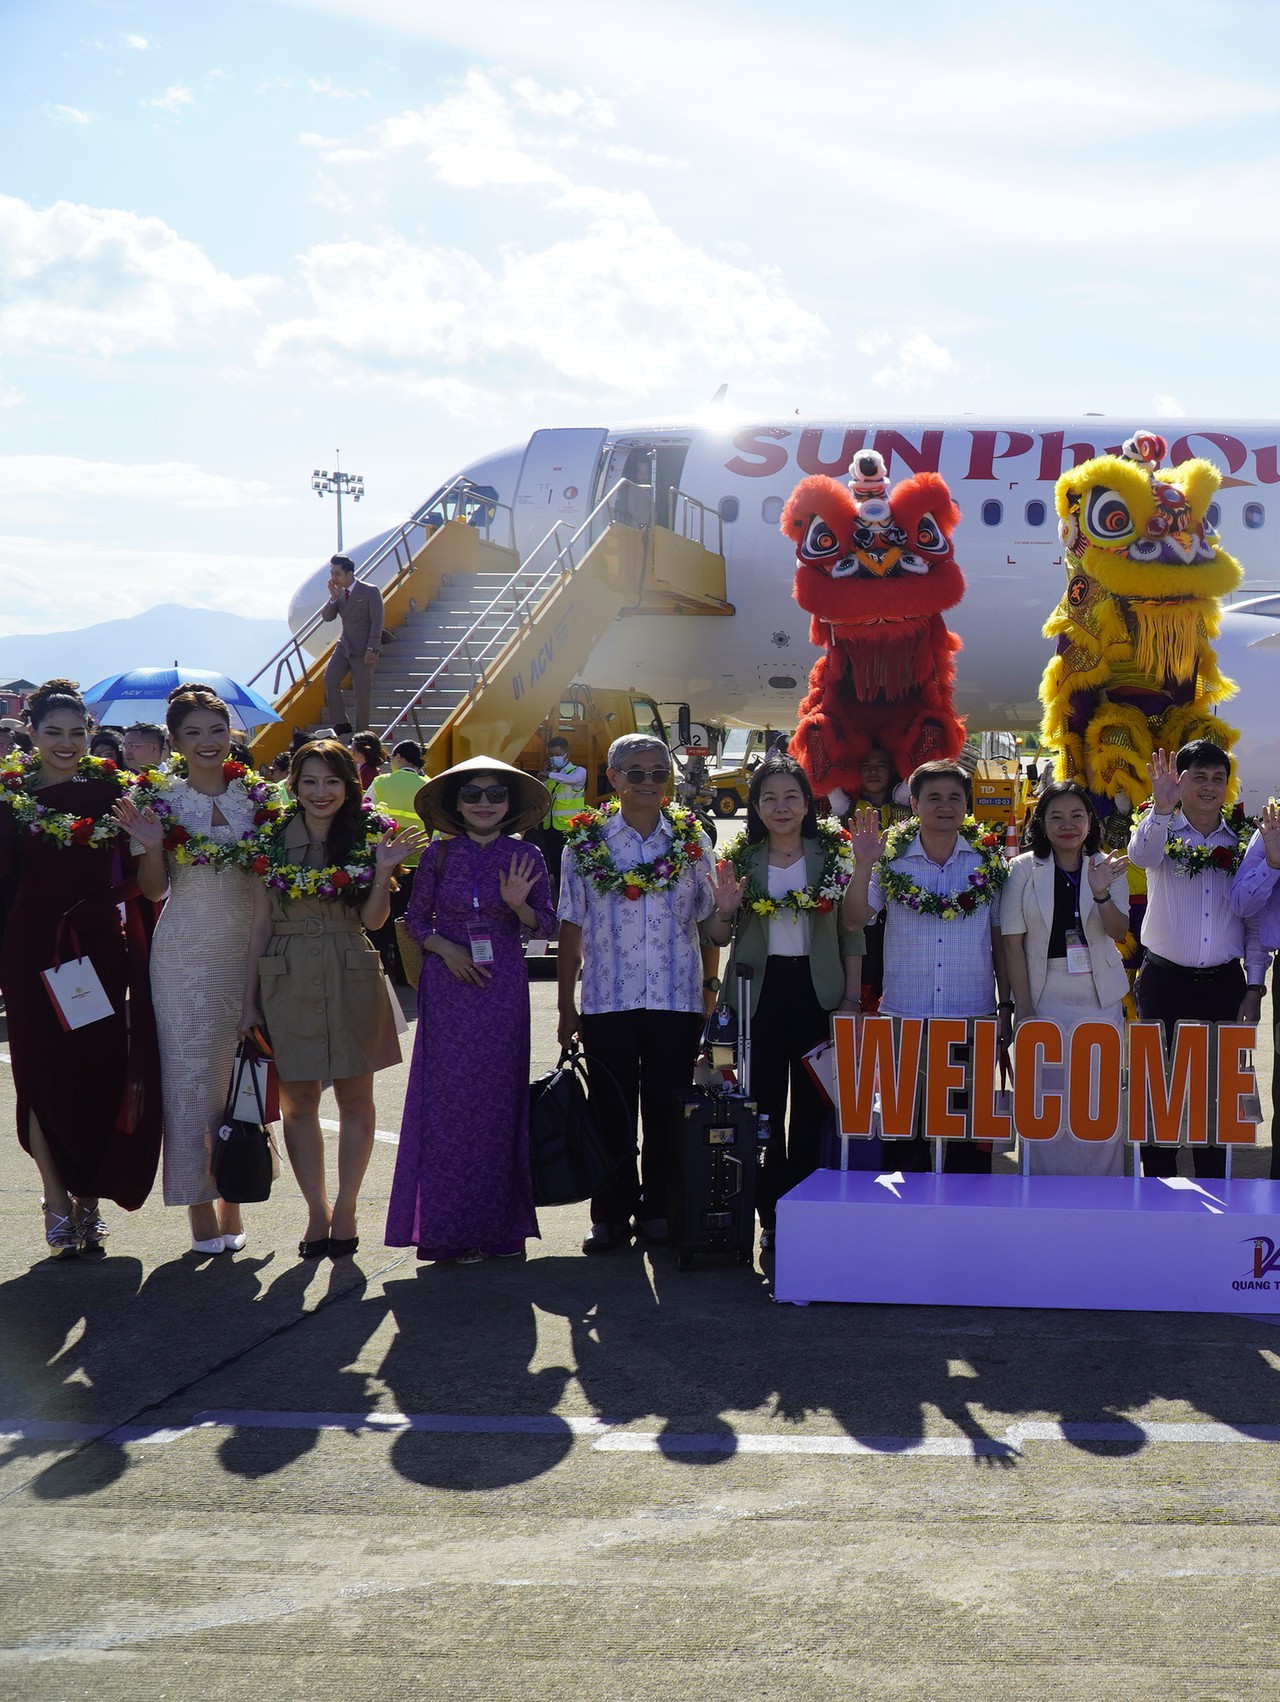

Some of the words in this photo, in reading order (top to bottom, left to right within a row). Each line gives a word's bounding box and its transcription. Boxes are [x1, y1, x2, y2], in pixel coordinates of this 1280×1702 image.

[723, 428, 944, 478] SUN
[511, 671, 525, 700] 01
[530, 634, 554, 689] ACV
[980, 785, 996, 794] TLD
[830, 1015, 1259, 1146] WELCOME
[1231, 1280, 1271, 1291] QUANG
